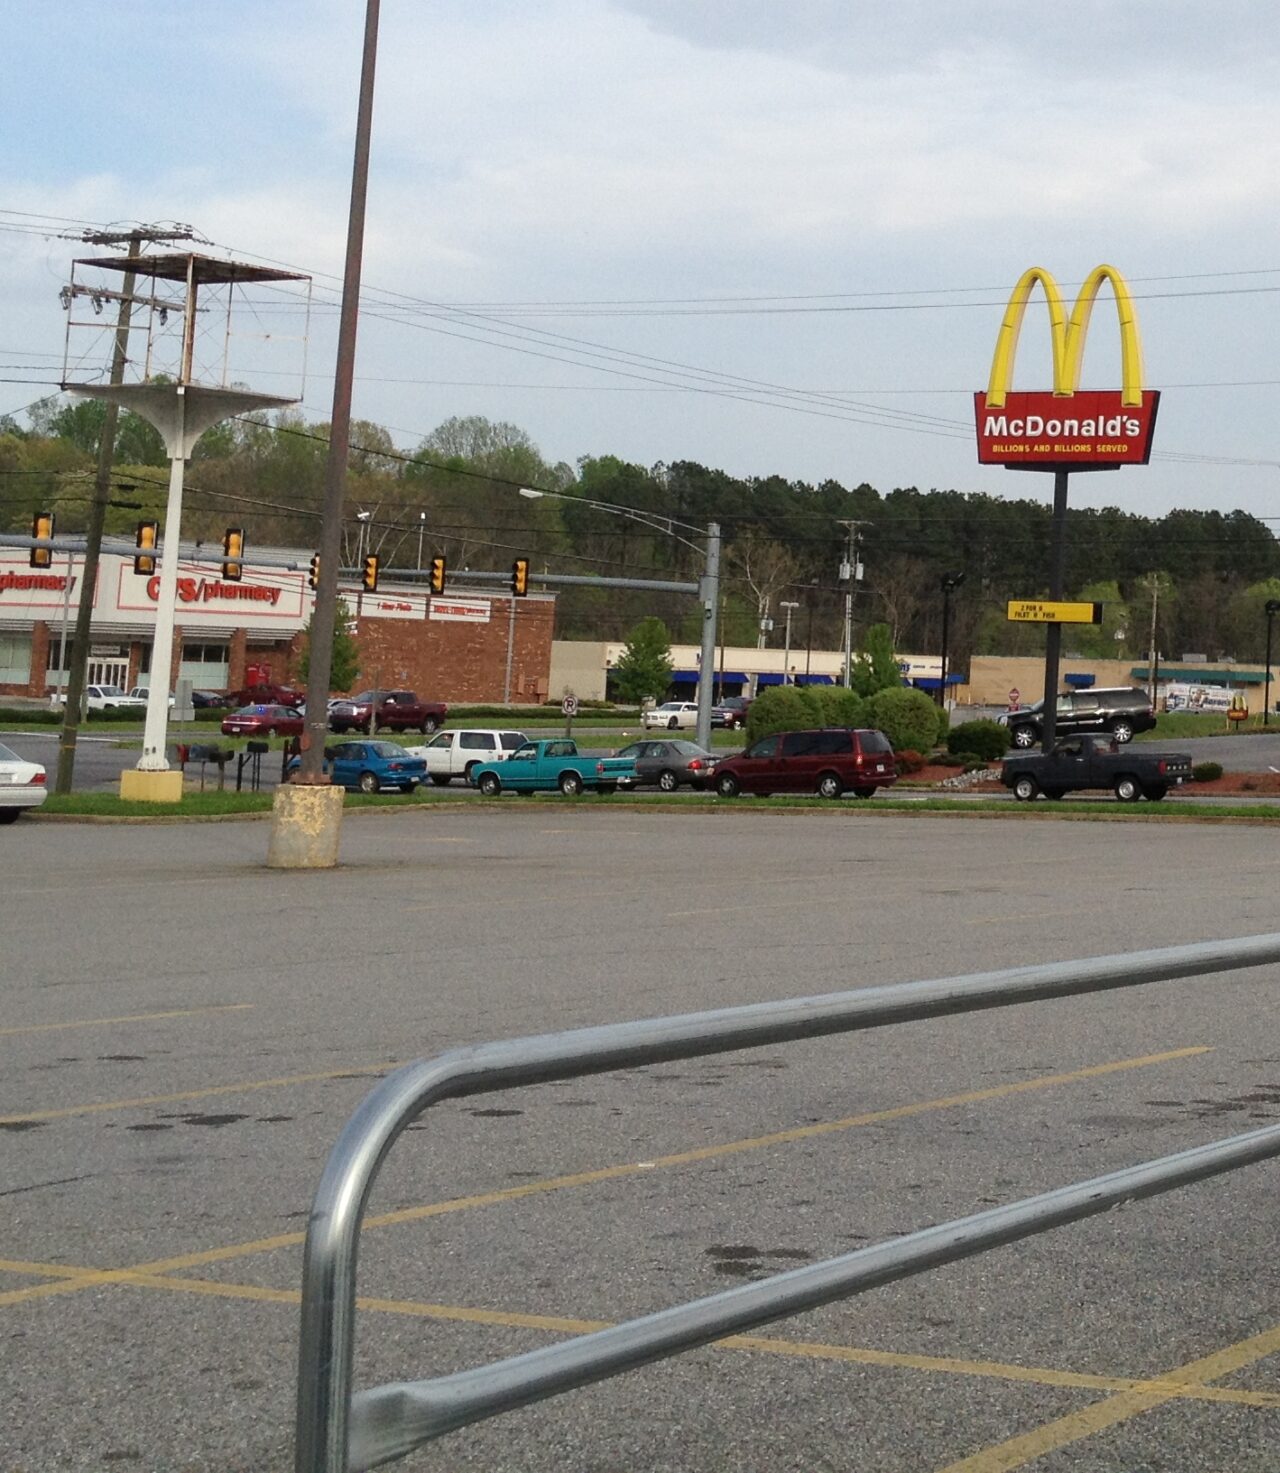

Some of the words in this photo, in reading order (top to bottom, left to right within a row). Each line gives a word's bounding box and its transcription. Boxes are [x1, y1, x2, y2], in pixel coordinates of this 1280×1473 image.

[984, 415, 1141, 437] McDonald's
[993, 444, 1030, 452] BILLIONS
[1034, 444, 1050, 452] AND
[1054, 444, 1091, 452] BILLIONS
[1096, 444, 1128, 452] SERVED
